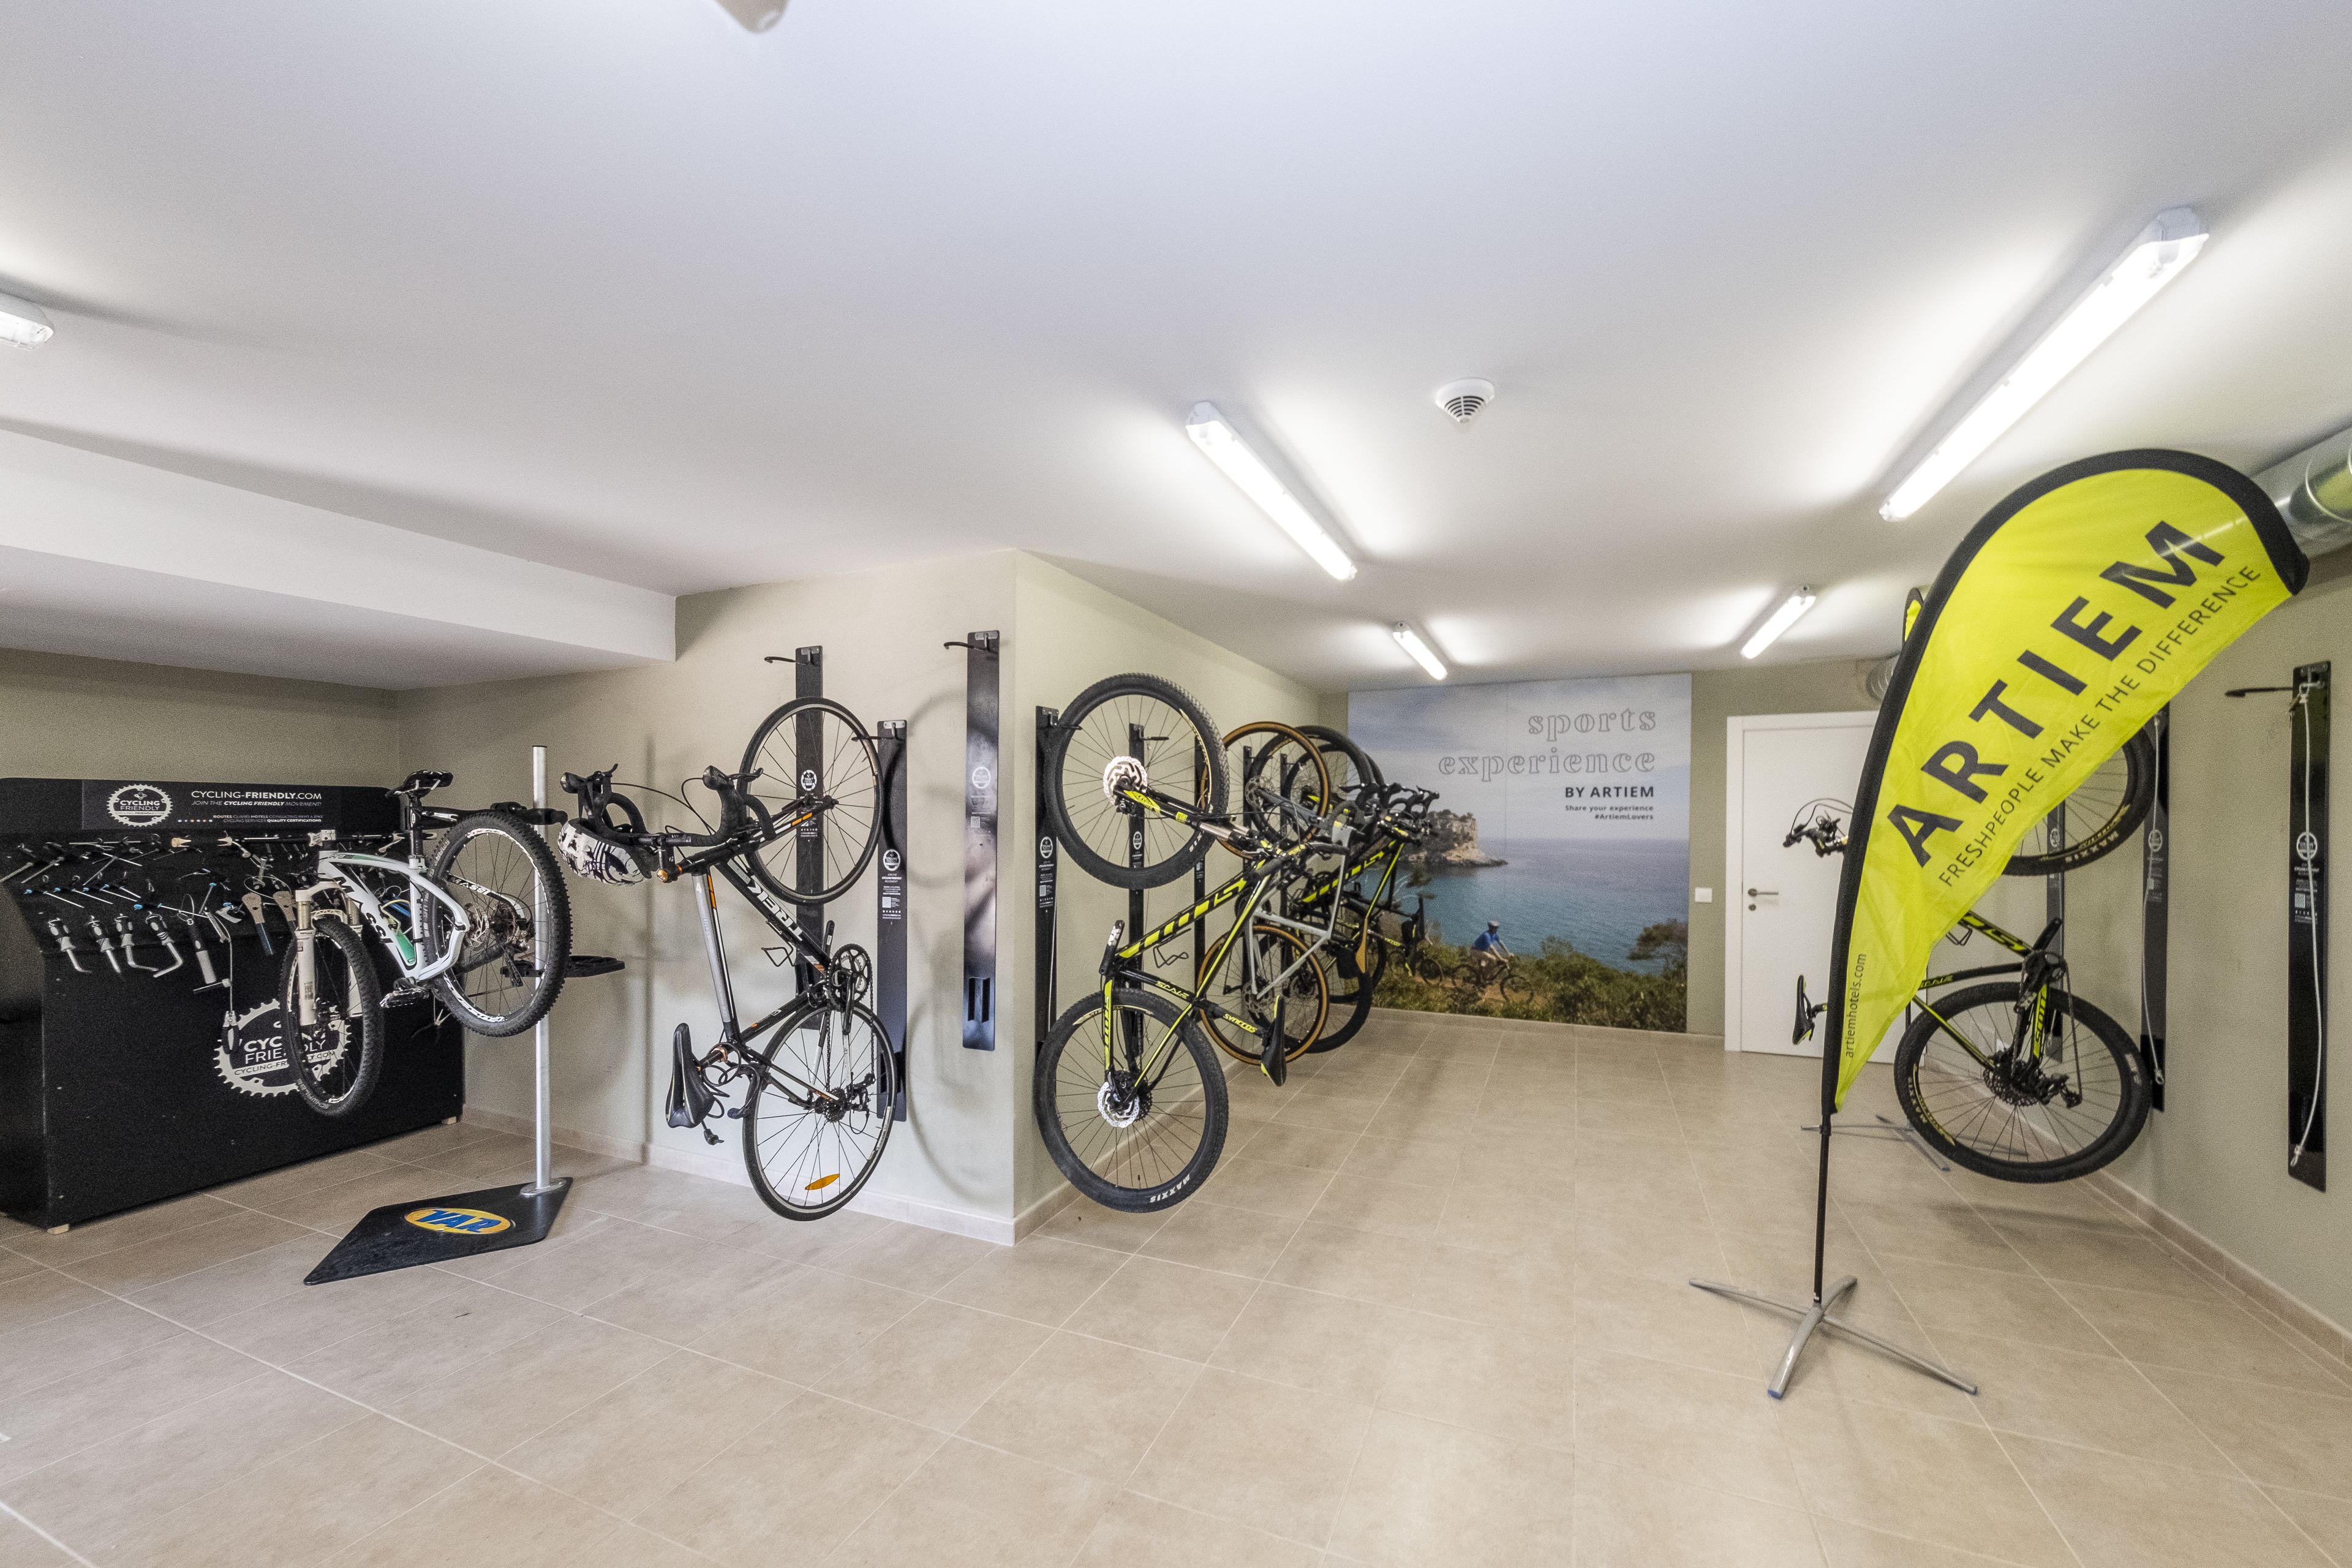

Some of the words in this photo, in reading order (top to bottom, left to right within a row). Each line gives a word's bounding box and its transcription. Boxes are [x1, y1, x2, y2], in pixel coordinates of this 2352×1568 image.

[1887, 520, 2226, 868] ARTIEM
[1528, 707, 1656, 742] sports
[1938, 769, 2045, 888] FRESHPEOPLE
[2041, 714, 2101, 769] MAKE
[2095, 675, 2141, 713] THE
[2136, 565, 2261, 676] DIFFERENCE
[1439, 747, 1656, 782] experience
[191, 791, 322, 799] CYCLING-FRIENDLY.COM
[1565, 786, 1585, 797] BY
[1590, 786, 1654, 797] ARTIEM
[747, 880, 804, 941] TREK
[1845, 953, 1867, 1058] artiemhotels.com
[1150, 1174, 1190, 1203] MAXXIS
[414, 1210, 502, 1233] VAR
